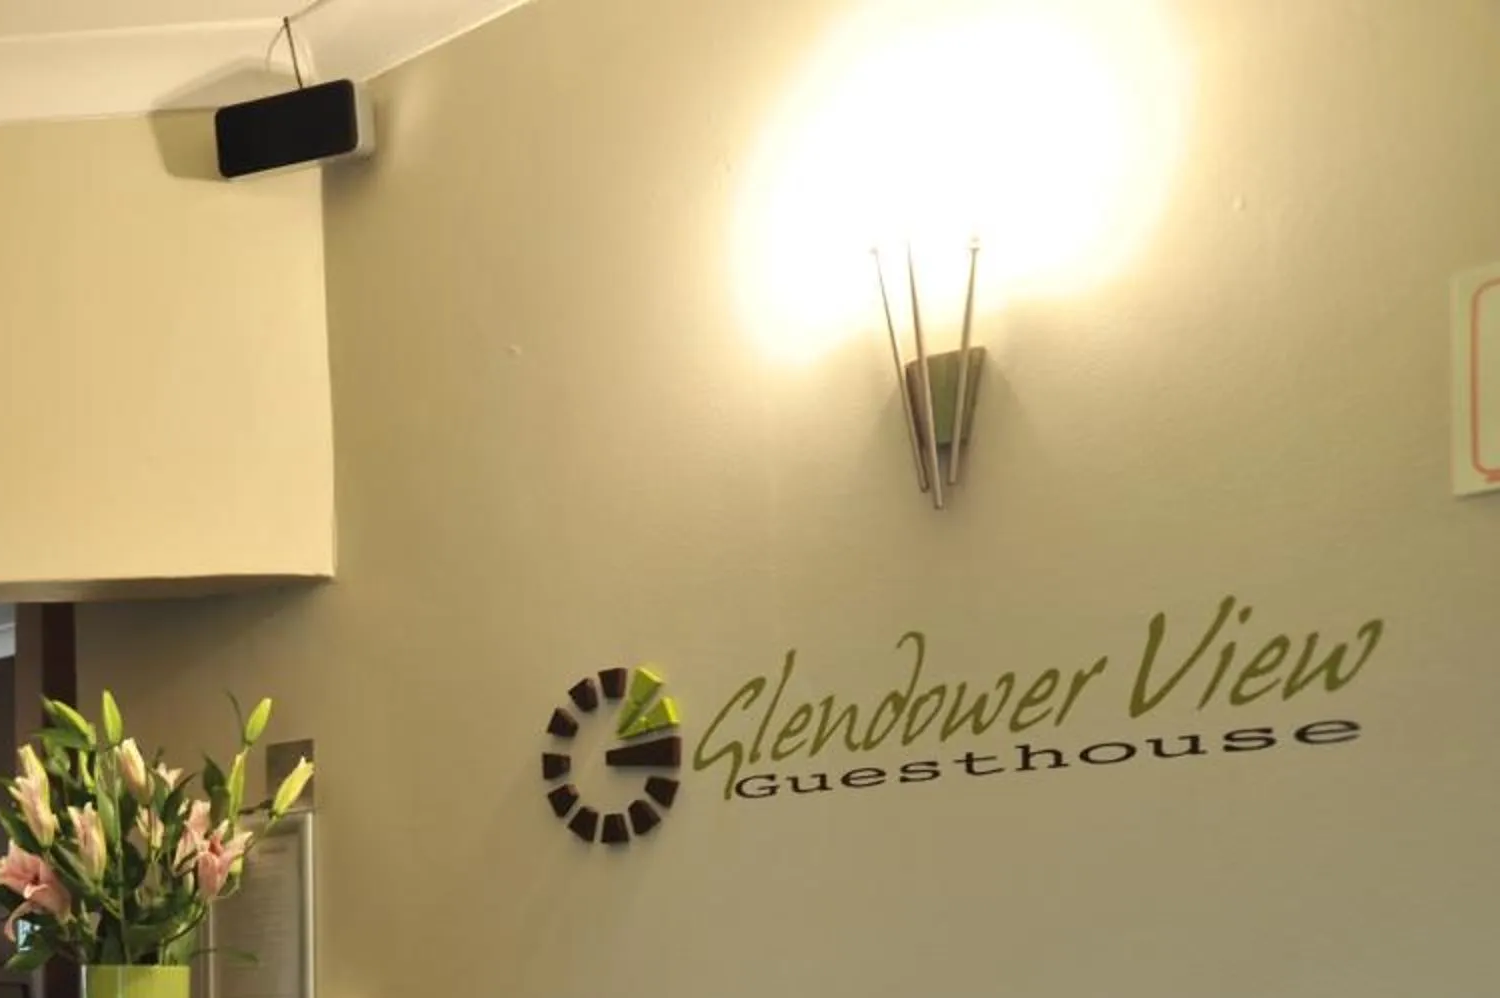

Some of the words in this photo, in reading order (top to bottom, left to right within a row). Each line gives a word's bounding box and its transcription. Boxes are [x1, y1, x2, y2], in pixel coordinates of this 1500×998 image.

[693, 631, 1108, 801] Glendower
[1128, 595, 1384, 719] View
[735, 718, 1362, 800] Guesthouse
